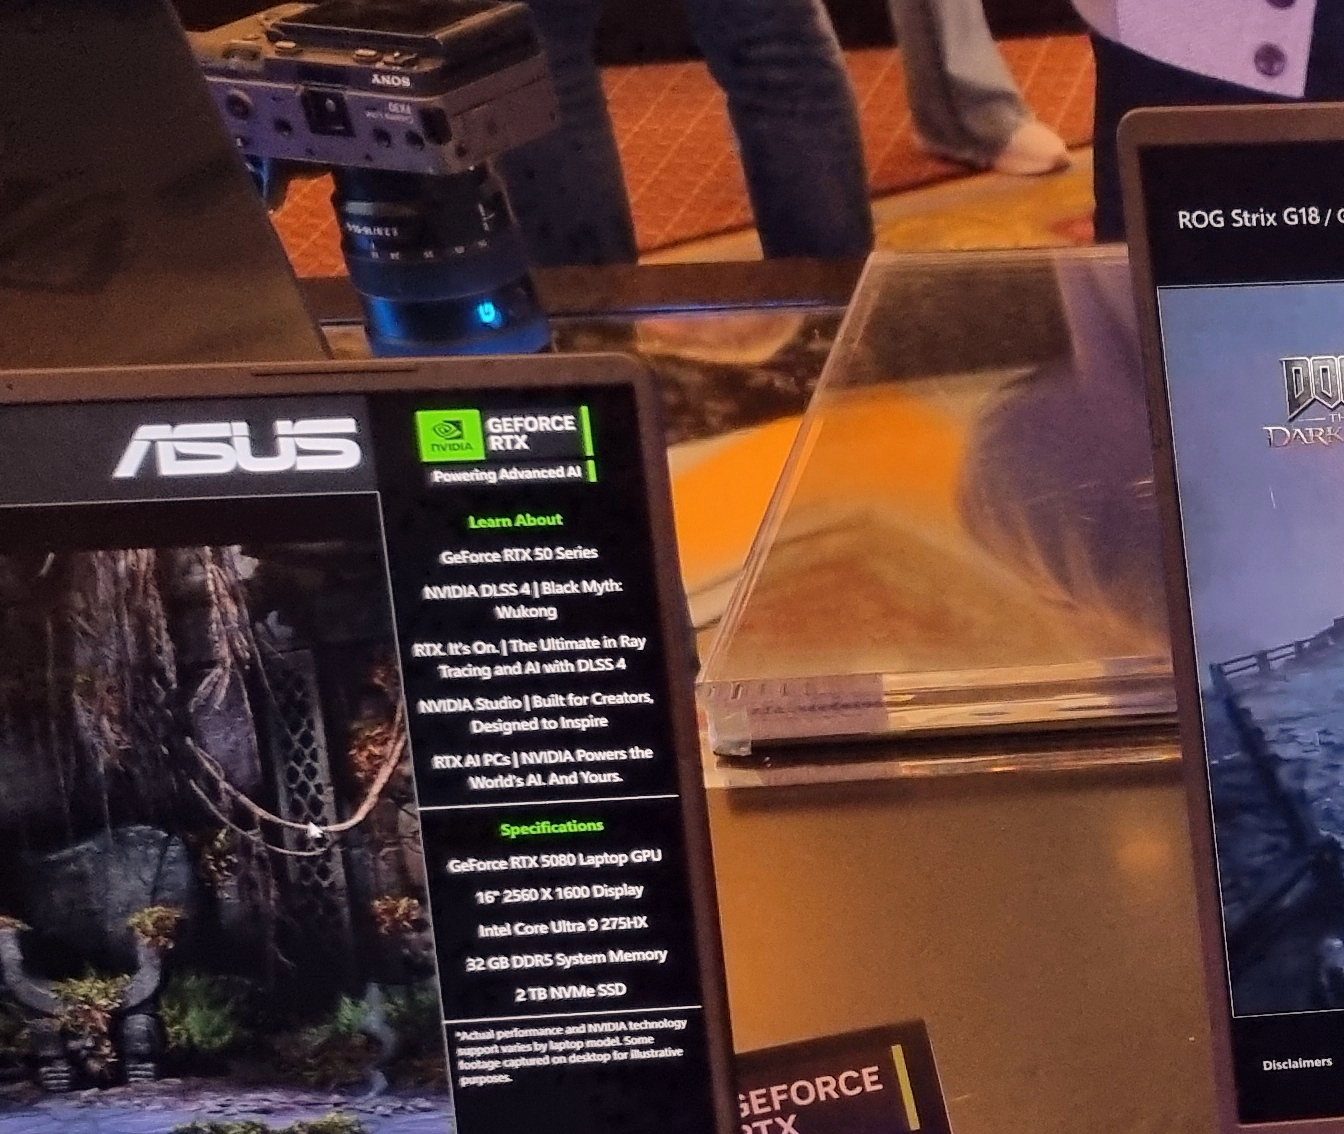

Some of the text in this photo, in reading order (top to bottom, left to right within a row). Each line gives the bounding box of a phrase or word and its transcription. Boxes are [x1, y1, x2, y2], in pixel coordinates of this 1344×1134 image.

[371, 73, 411, 87] SONY
[1179, 210, 1224, 228] ROG
[1231, 209, 1277, 227] Strix
[1284, 207, 1320, 225] G18
[487, 415, 576, 433] GEFORCE
[113, 418, 361, 477] ASUS
[431, 442, 473, 452] NVIDIA
[489, 435, 529, 450] RTX
[433, 466, 581, 483] Powering Advanced AI
[469, 514, 563, 528] Learn About
[503, 888, 539, 902] 2560
[541, 888, 553, 900] X
[555, 886, 590, 899] 1600
[592, 883, 644, 899] Display
[516, 983, 626, 1001] 2 TB NVMe SSD
[1263, 1058, 1332, 1070] Disclaimers
